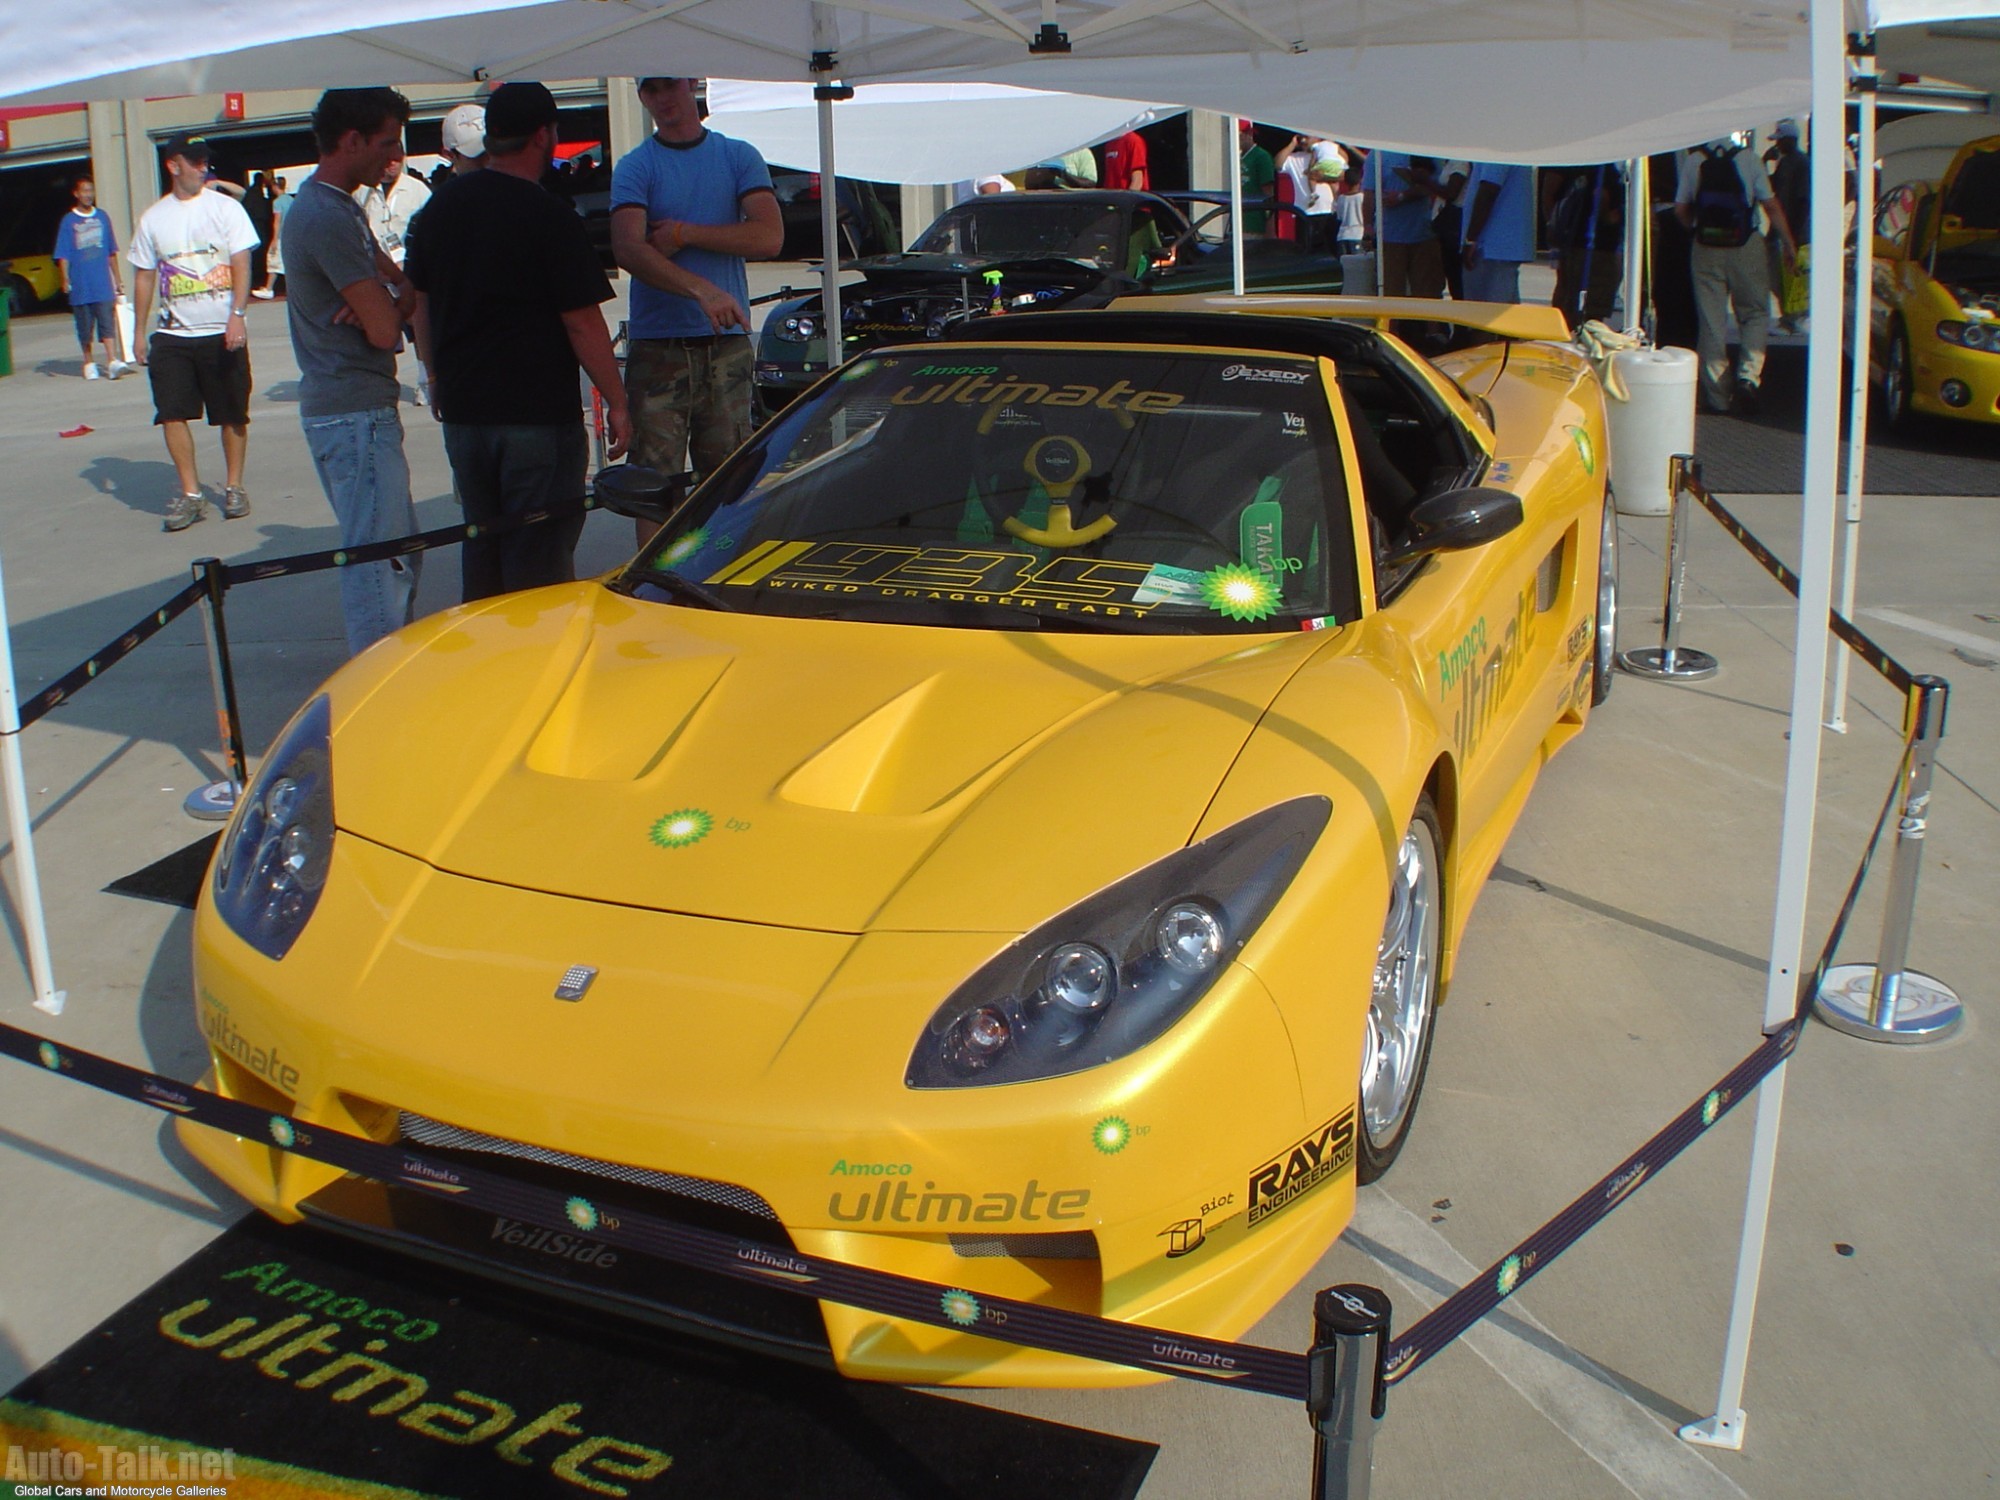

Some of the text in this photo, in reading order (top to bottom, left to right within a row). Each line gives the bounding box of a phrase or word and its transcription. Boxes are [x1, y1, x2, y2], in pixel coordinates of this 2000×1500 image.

[911, 365, 999, 376] Amoco
[1239, 368, 1310, 380] EXEDY
[890, 375, 1184, 414] ultimate
[1268, 555, 1303, 574] bp
[770, 580, 1148, 619] WIKED DRAGGER EAST
[1439, 615, 1487, 703] Amoco
[725, 816, 751, 832] bp
[203, 1011, 300, 1095] ultimate
[1135, 1124, 1151, 1137] bp
[829, 1159, 912, 1176] Amoco
[1249, 1108, 1354, 1206] RAYS
[404, 1161, 460, 1184] ultimate
[1248, 1144, 1354, 1223] ENGINEERING
[828, 1179, 1092, 1223] ultimate
[600, 1211, 620, 1229] bp
[491, 1217, 618, 1269] VeilSide
[738, 1248, 808, 1273] ultimate
[221, 1261, 440, 1343] Amoco
[985, 1305, 1008, 1324] bp
[1152, 1343, 1236, 1369] ultimate
[158, 1298, 673, 1497] ultimate
